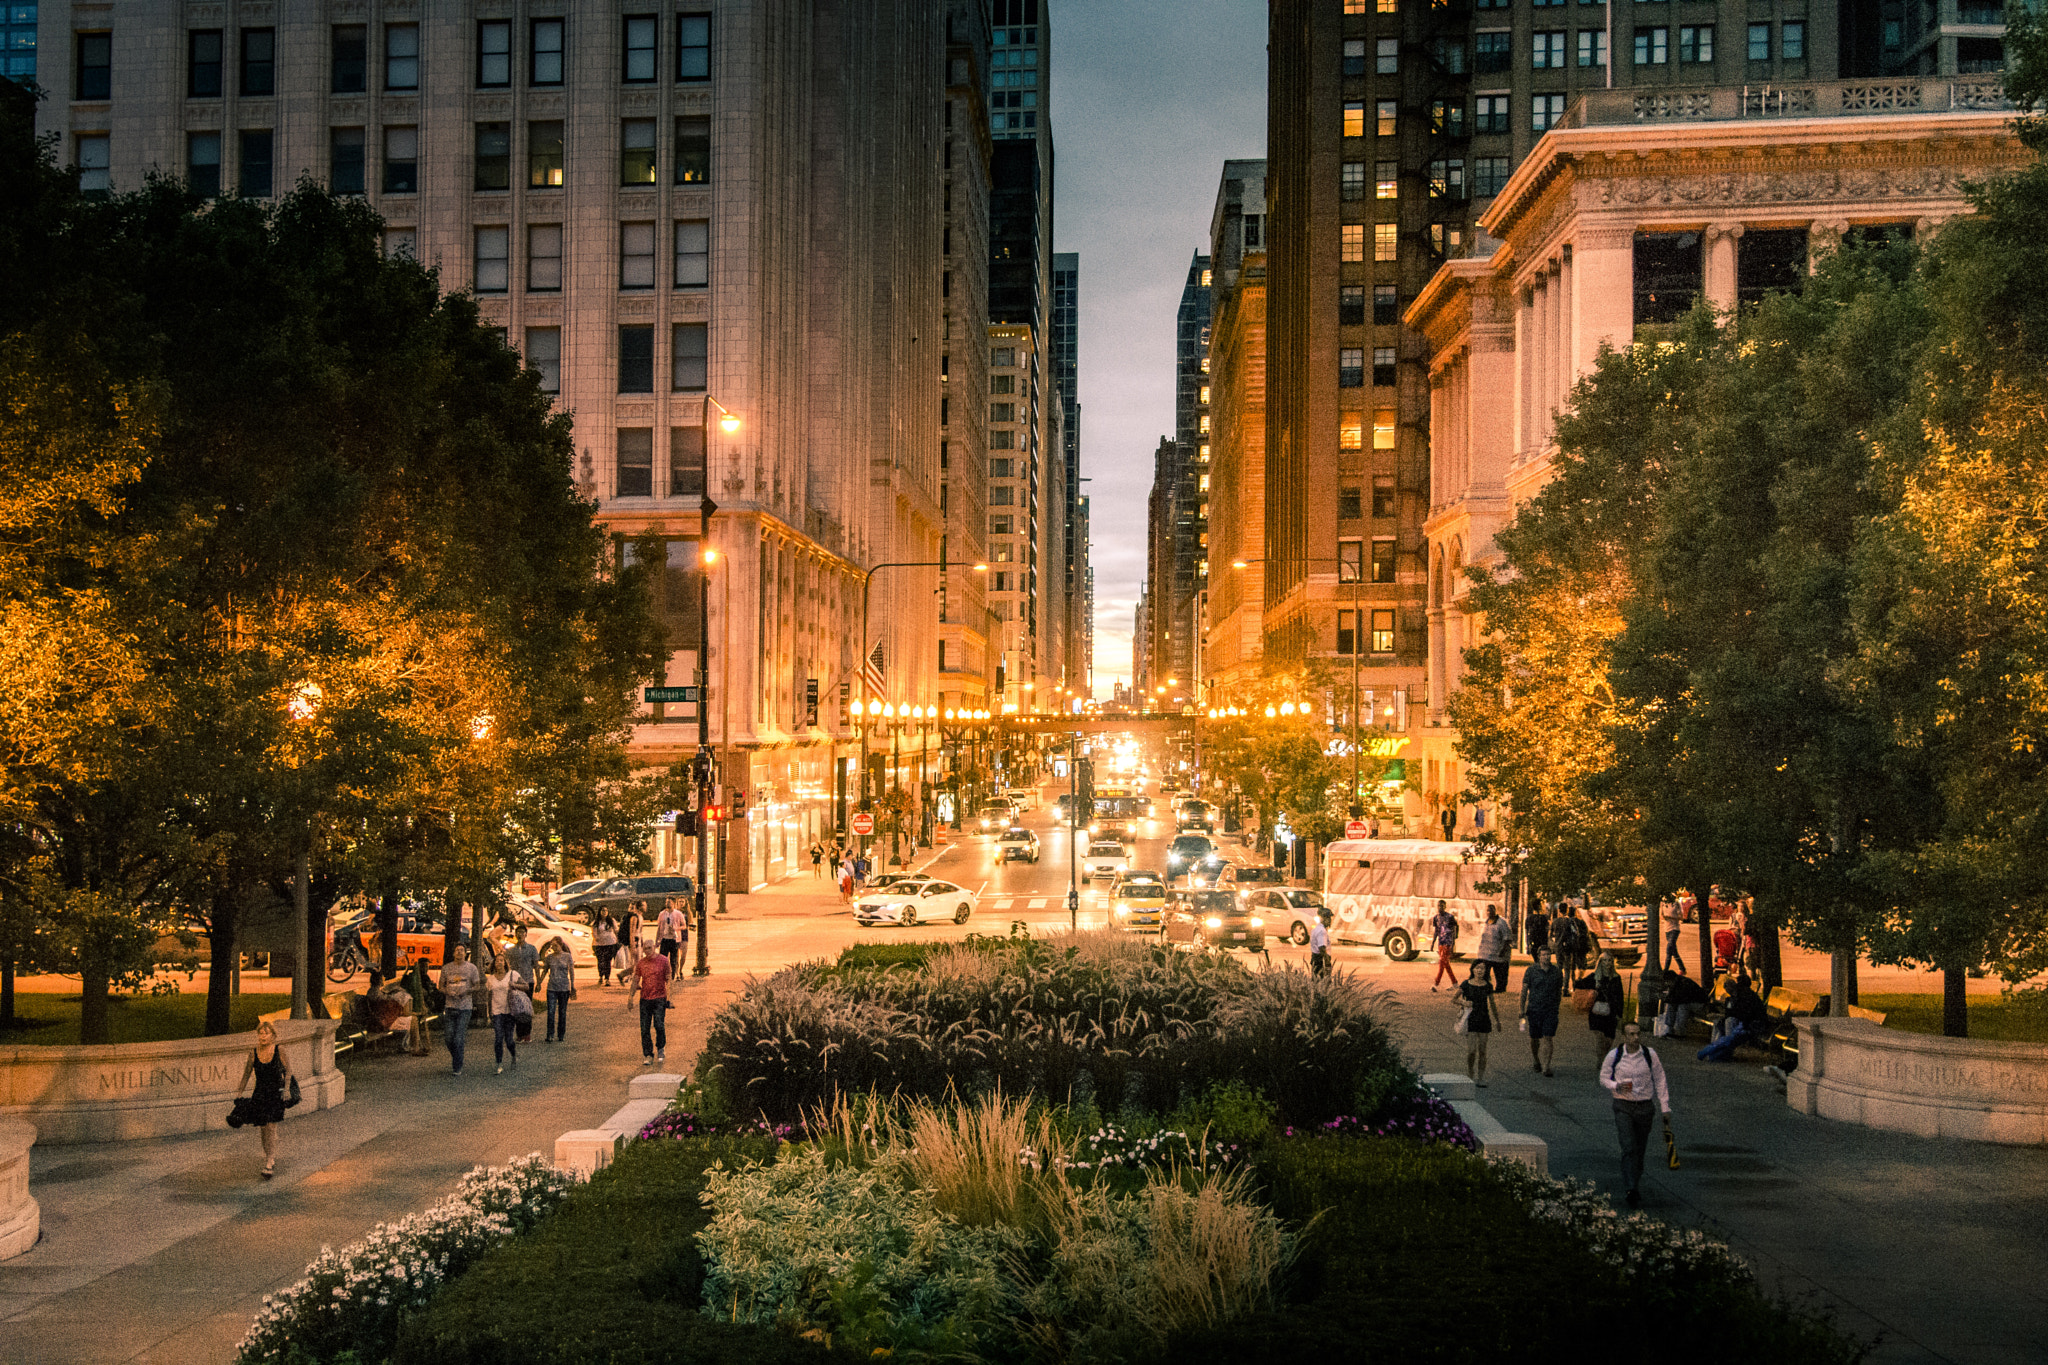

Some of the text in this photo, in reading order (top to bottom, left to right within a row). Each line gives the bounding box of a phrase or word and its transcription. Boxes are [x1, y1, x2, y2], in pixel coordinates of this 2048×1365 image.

[651, 690, 679, 701] Michigan
[100, 1065, 228, 1090] MILLENNIUM
[1859, 1059, 1978, 1087] MILLENNIUM
